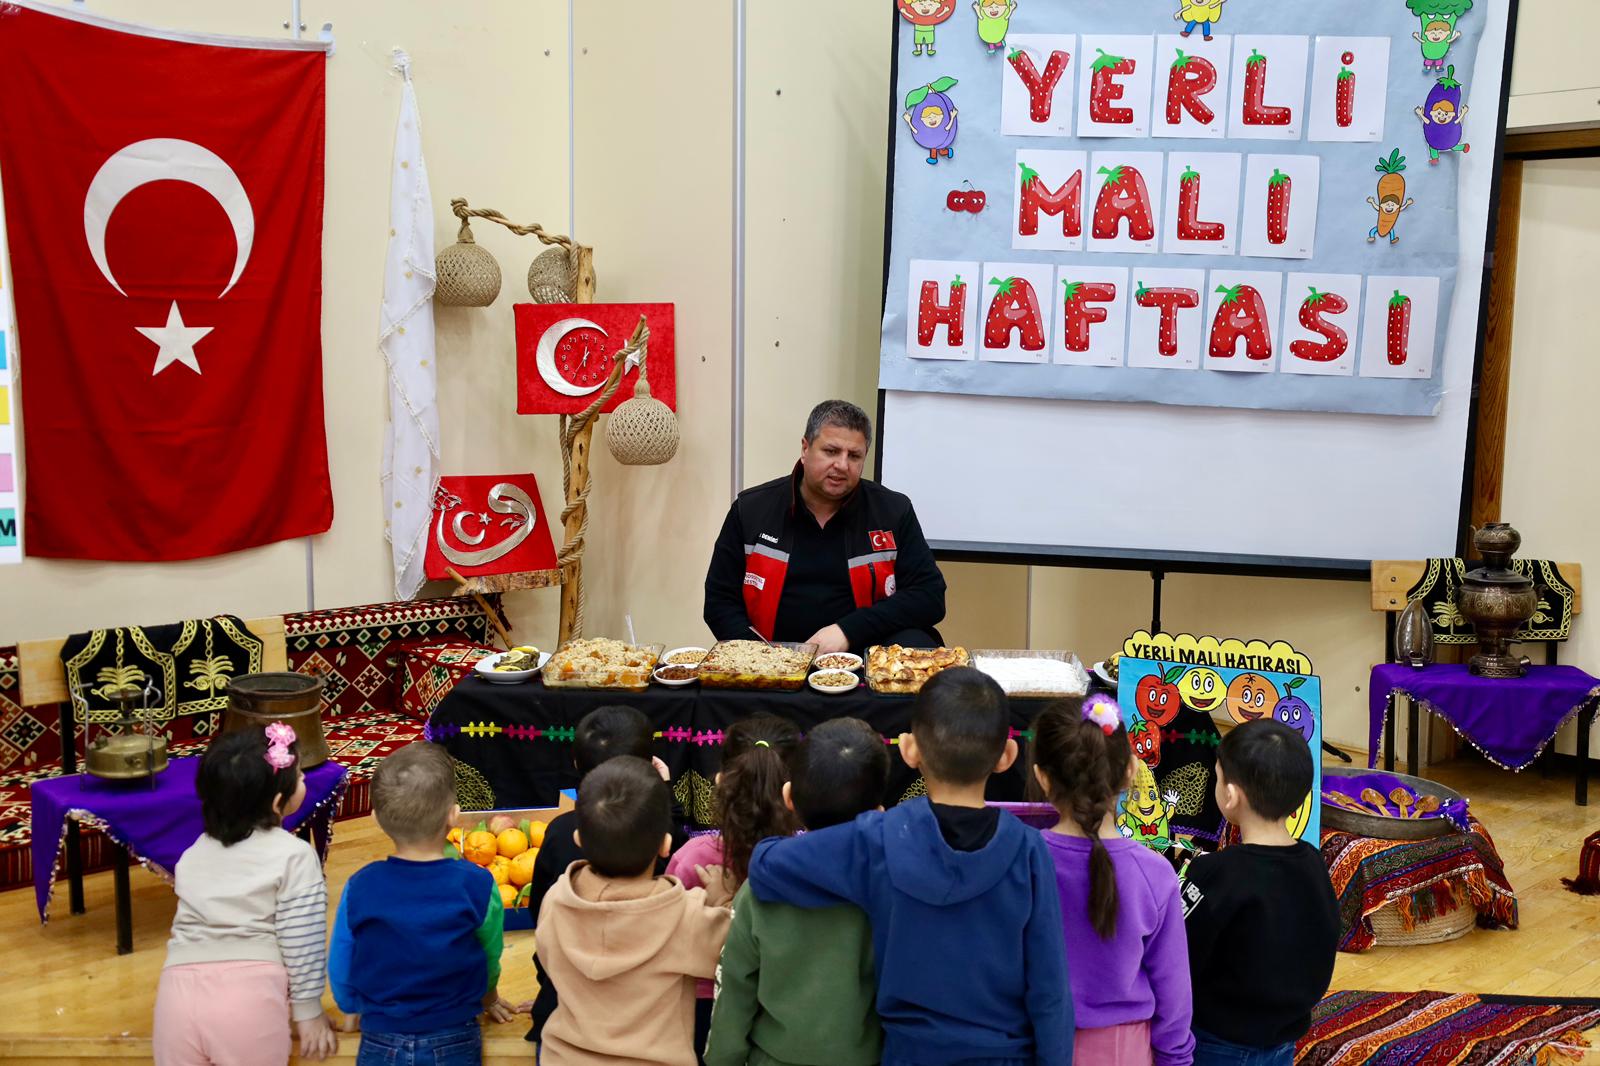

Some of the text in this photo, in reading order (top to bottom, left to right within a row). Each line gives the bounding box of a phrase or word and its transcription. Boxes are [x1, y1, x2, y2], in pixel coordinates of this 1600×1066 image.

[1018, 162, 1292, 244] MALI
[917, 275, 1411, 366] HAFTASI
[1179, 649, 1221, 667] MALI
[1225, 652, 1301, 674] HATIRASI
